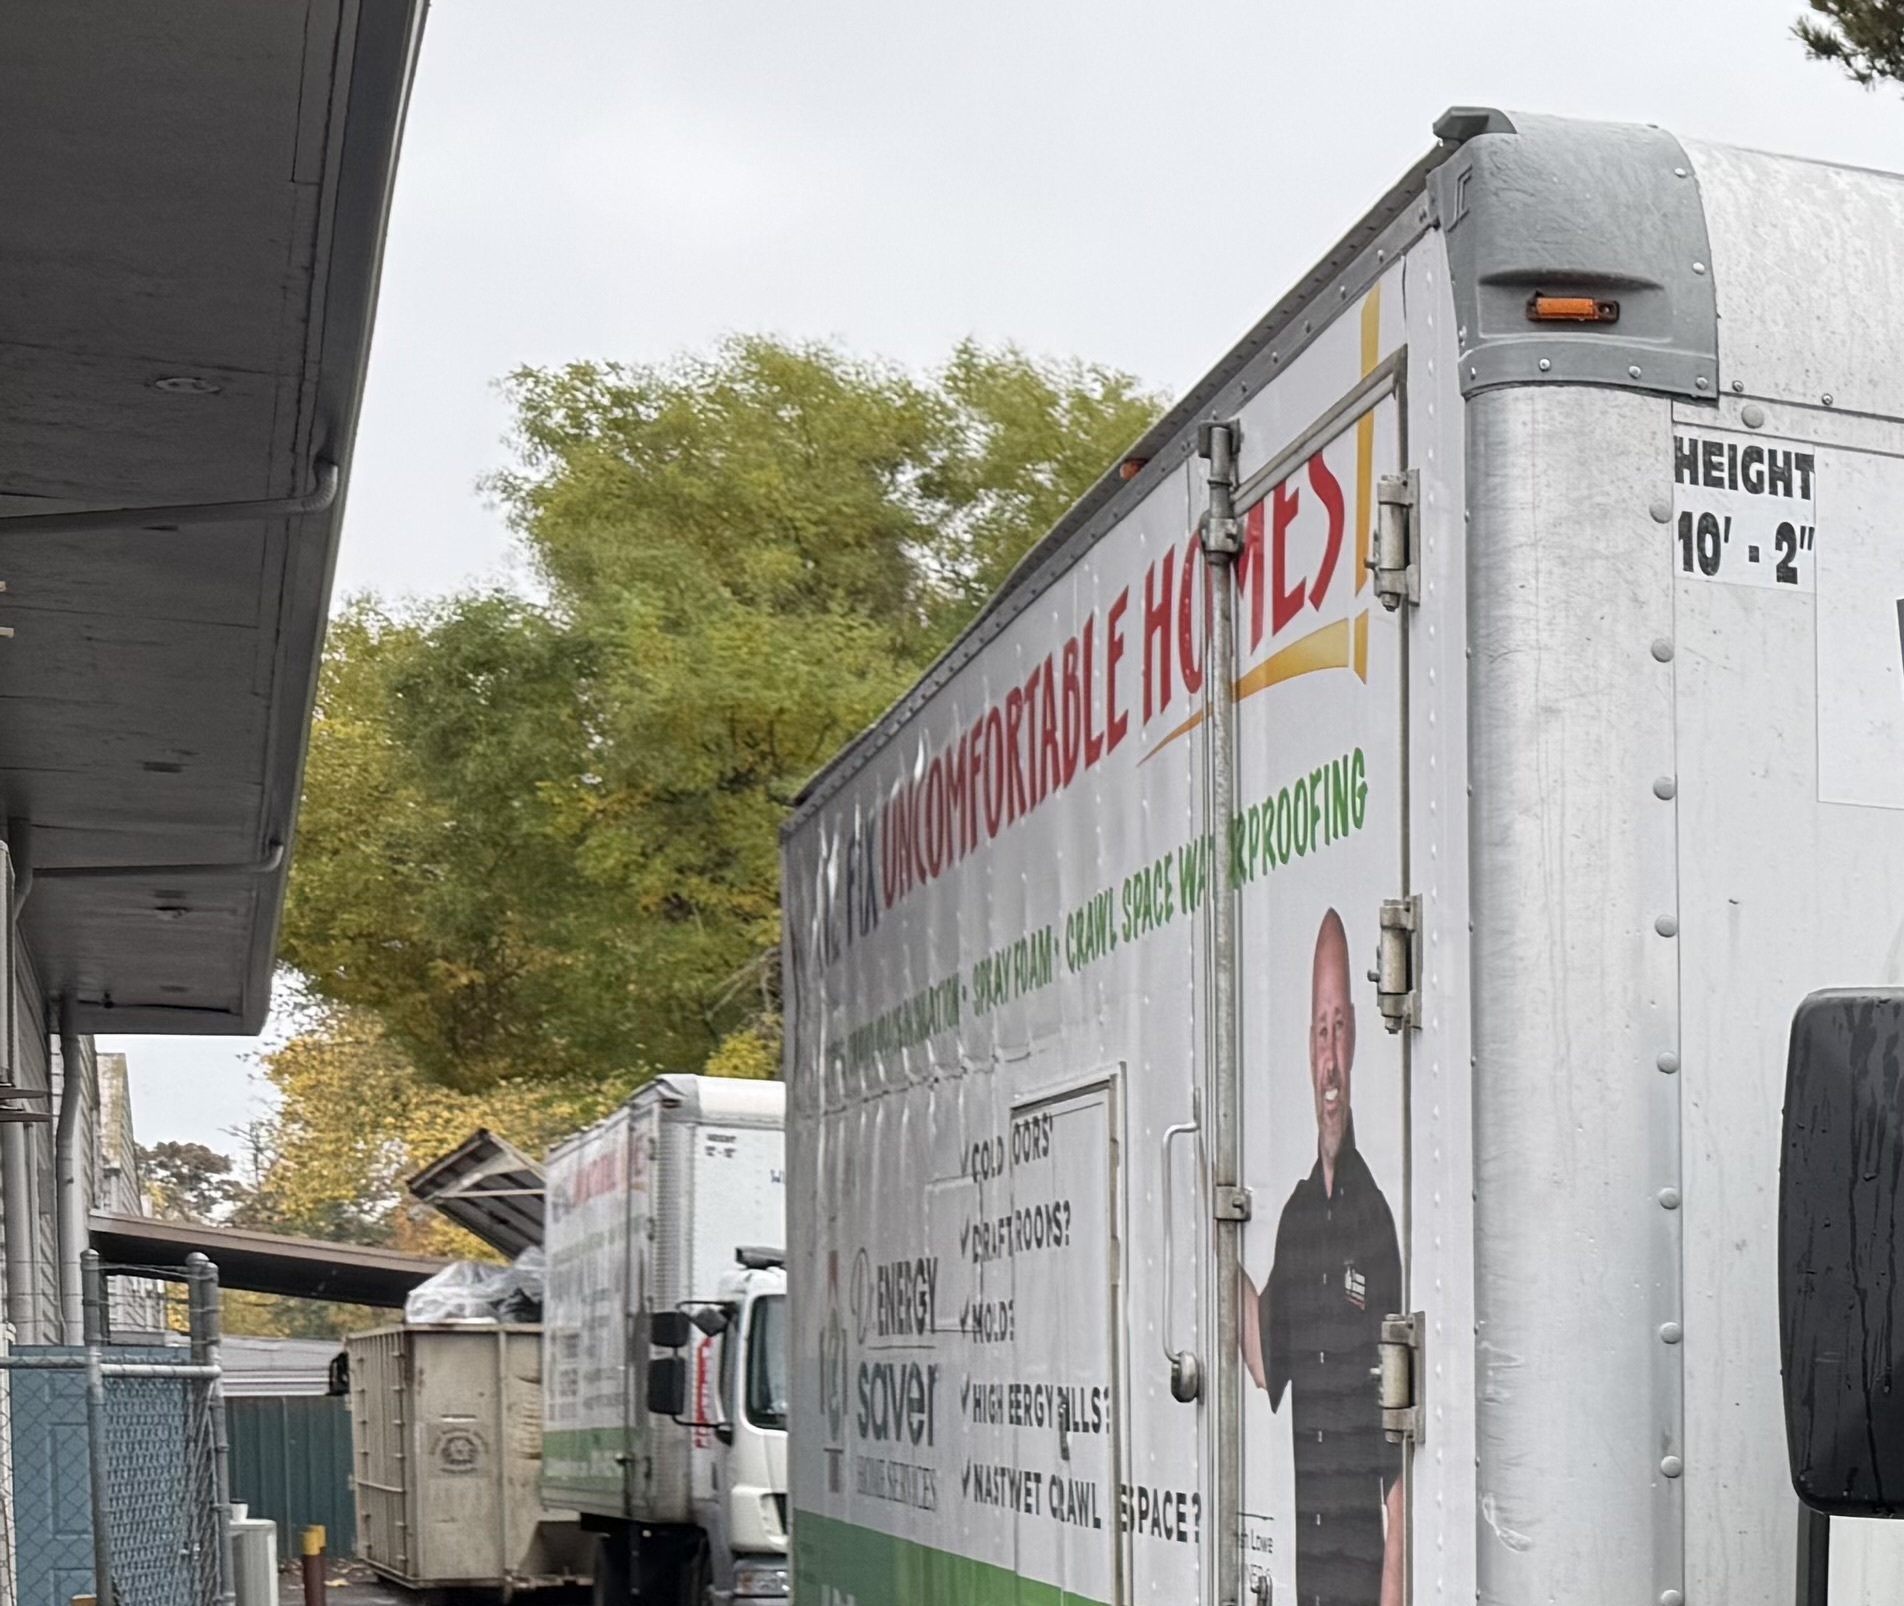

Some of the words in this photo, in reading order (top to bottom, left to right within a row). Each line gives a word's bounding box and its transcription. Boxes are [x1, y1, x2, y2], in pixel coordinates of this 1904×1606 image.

[1674, 436, 1815, 500] HEIGHT
[1677, 511, 1732, 577] 10'
[1775, 522, 1815, 585] 2"
[877, 584, 1130, 909] UNCOMFORTABLE
[973, 945, 1010, 1016] SPRAY
[1014, 924, 1052, 1000] FOAM
[1066, 887, 1117, 974] CRAWL
[1122, 852, 1174, 943] SPACE
[1179, 747, 1368, 915] WARPROOFING
[972, 1216, 1013, 1264] DRAFT
[877, 1257, 938, 1336] ENERGY
[857, 1361, 940, 1446] saver
[973, 1383, 1004, 1425] HIGH
[1008, 1384, 1053, 1428] EERGY
[1049, 1474, 1102, 1529] CRAWL
